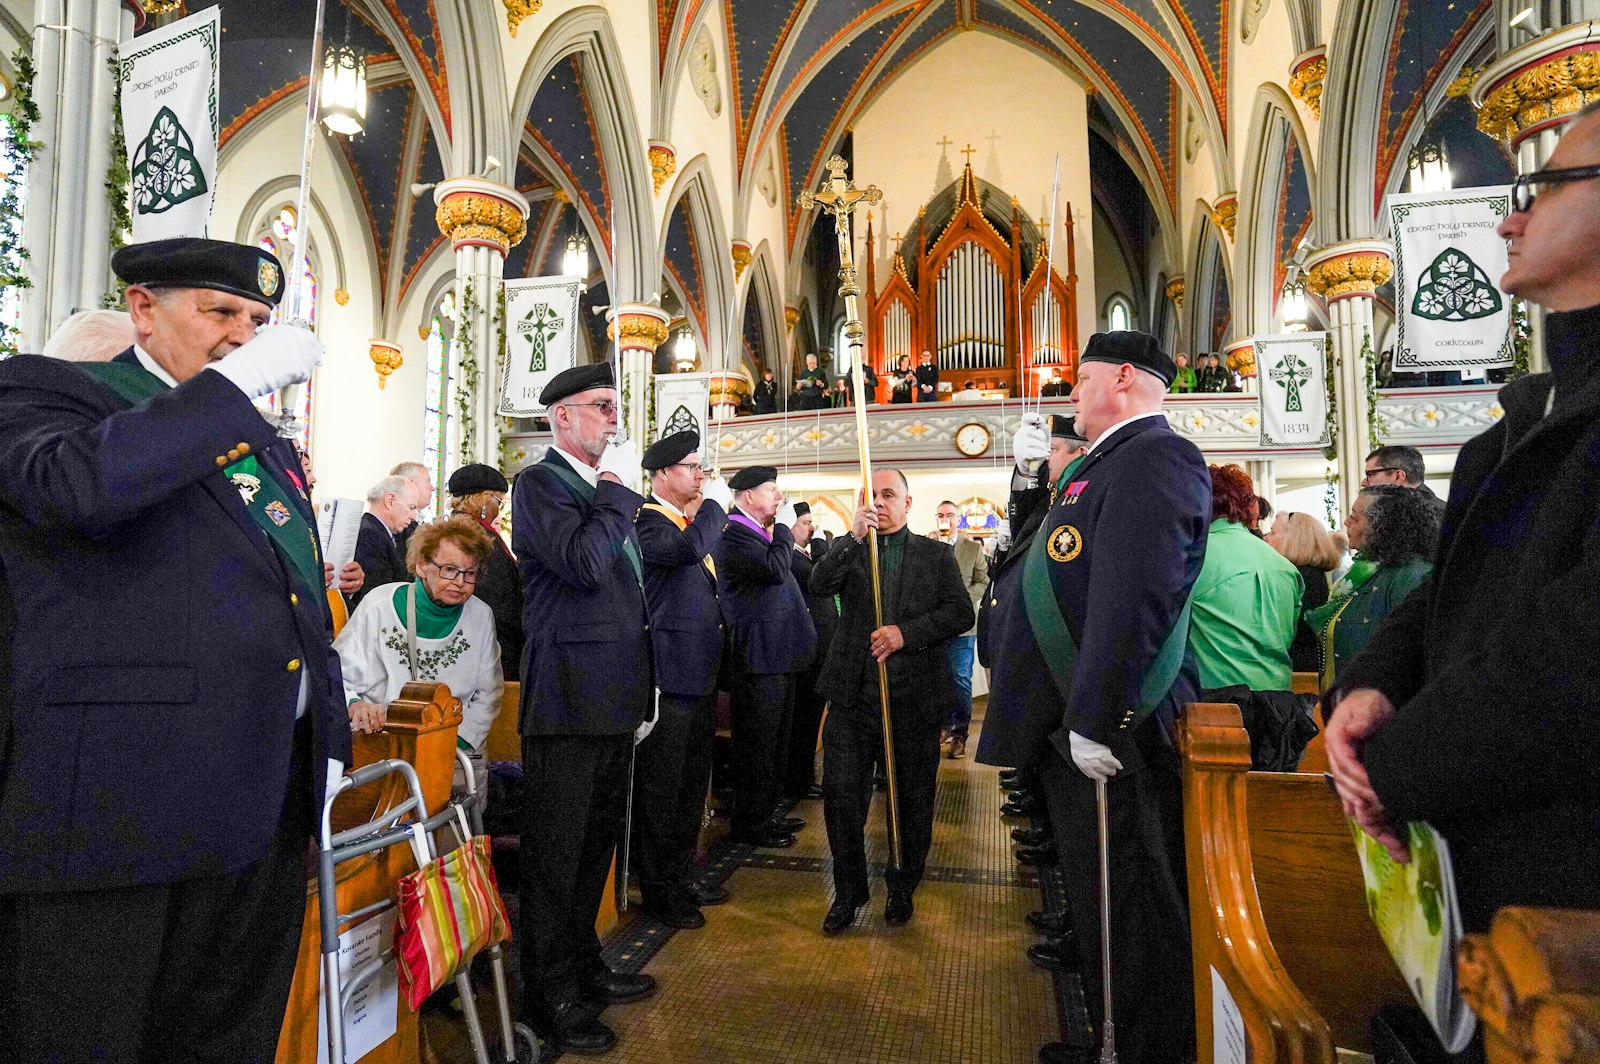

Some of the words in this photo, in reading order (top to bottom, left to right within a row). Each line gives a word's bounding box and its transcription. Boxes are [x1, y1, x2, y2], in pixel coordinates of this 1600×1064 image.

[1461, 221, 1495, 229] TRINITY
[523, 386, 543, 399] 183
[1283, 423, 1310, 434] 1834
[341, 939, 365, 955] Kosanke
[365, 929, 383, 941] Family
[351, 955, 372, 968] Catherine
[354, 1003, 366, 1015] David
